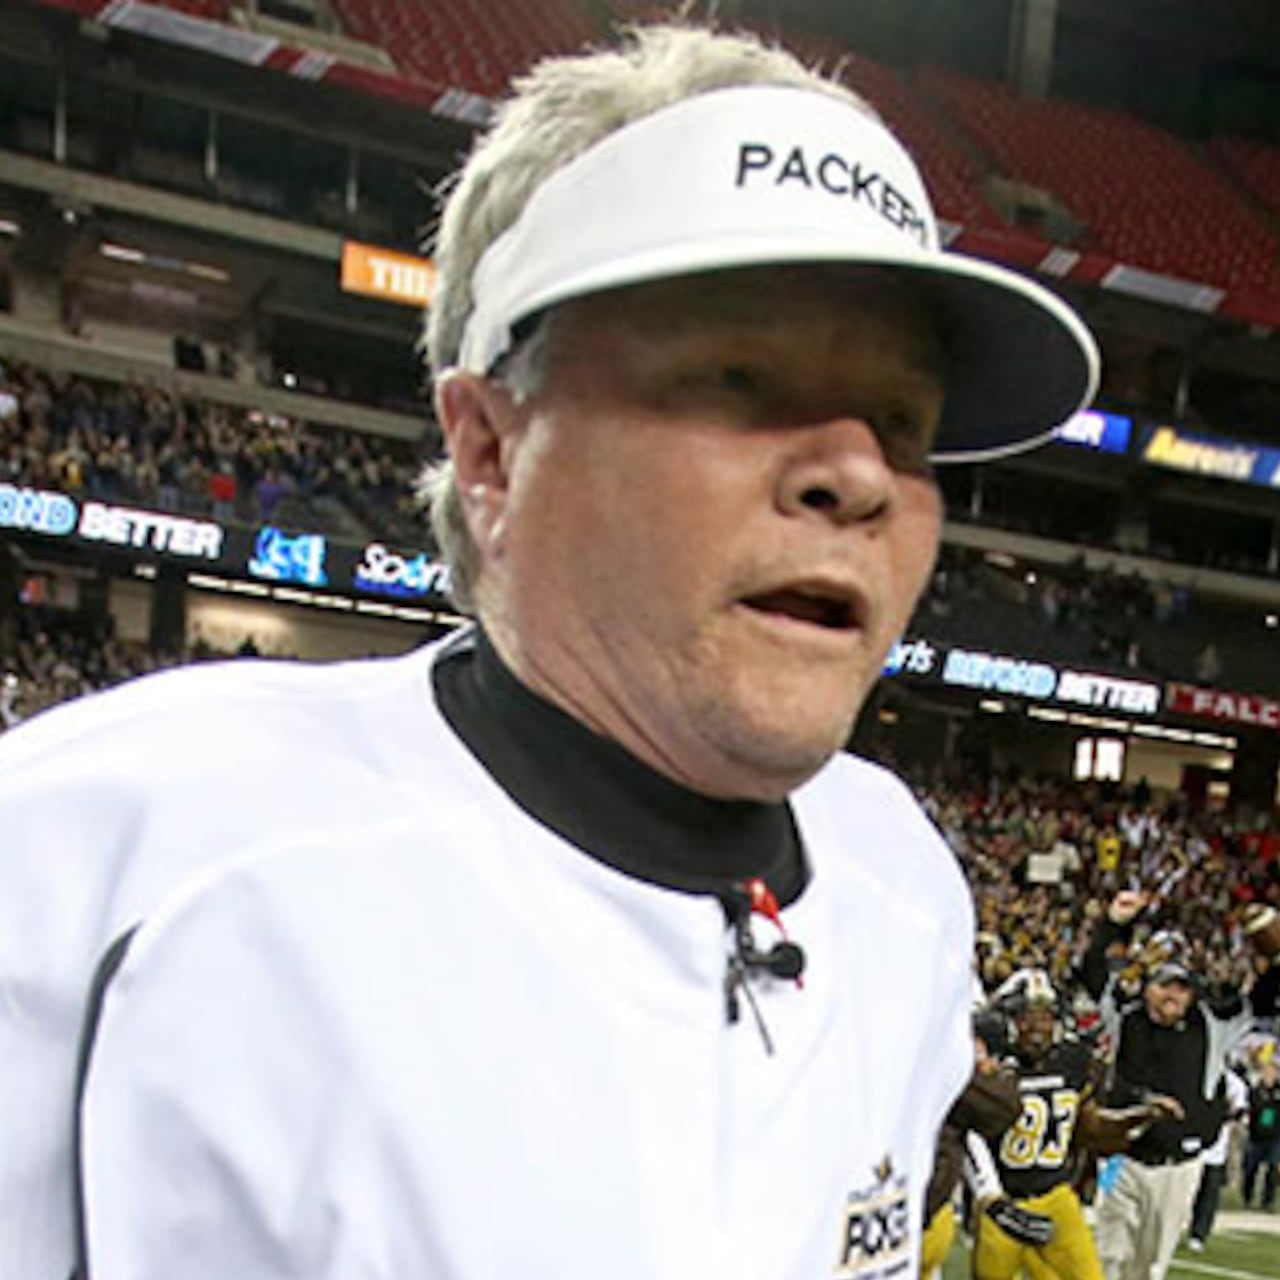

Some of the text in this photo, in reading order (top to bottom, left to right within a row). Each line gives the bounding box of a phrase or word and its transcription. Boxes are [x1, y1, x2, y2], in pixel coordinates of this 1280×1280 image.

[79, 501, 223, 560] BETTER
[943, 647, 1056, 698] BEYOND
[1055, 670, 1161, 714] BETTER
